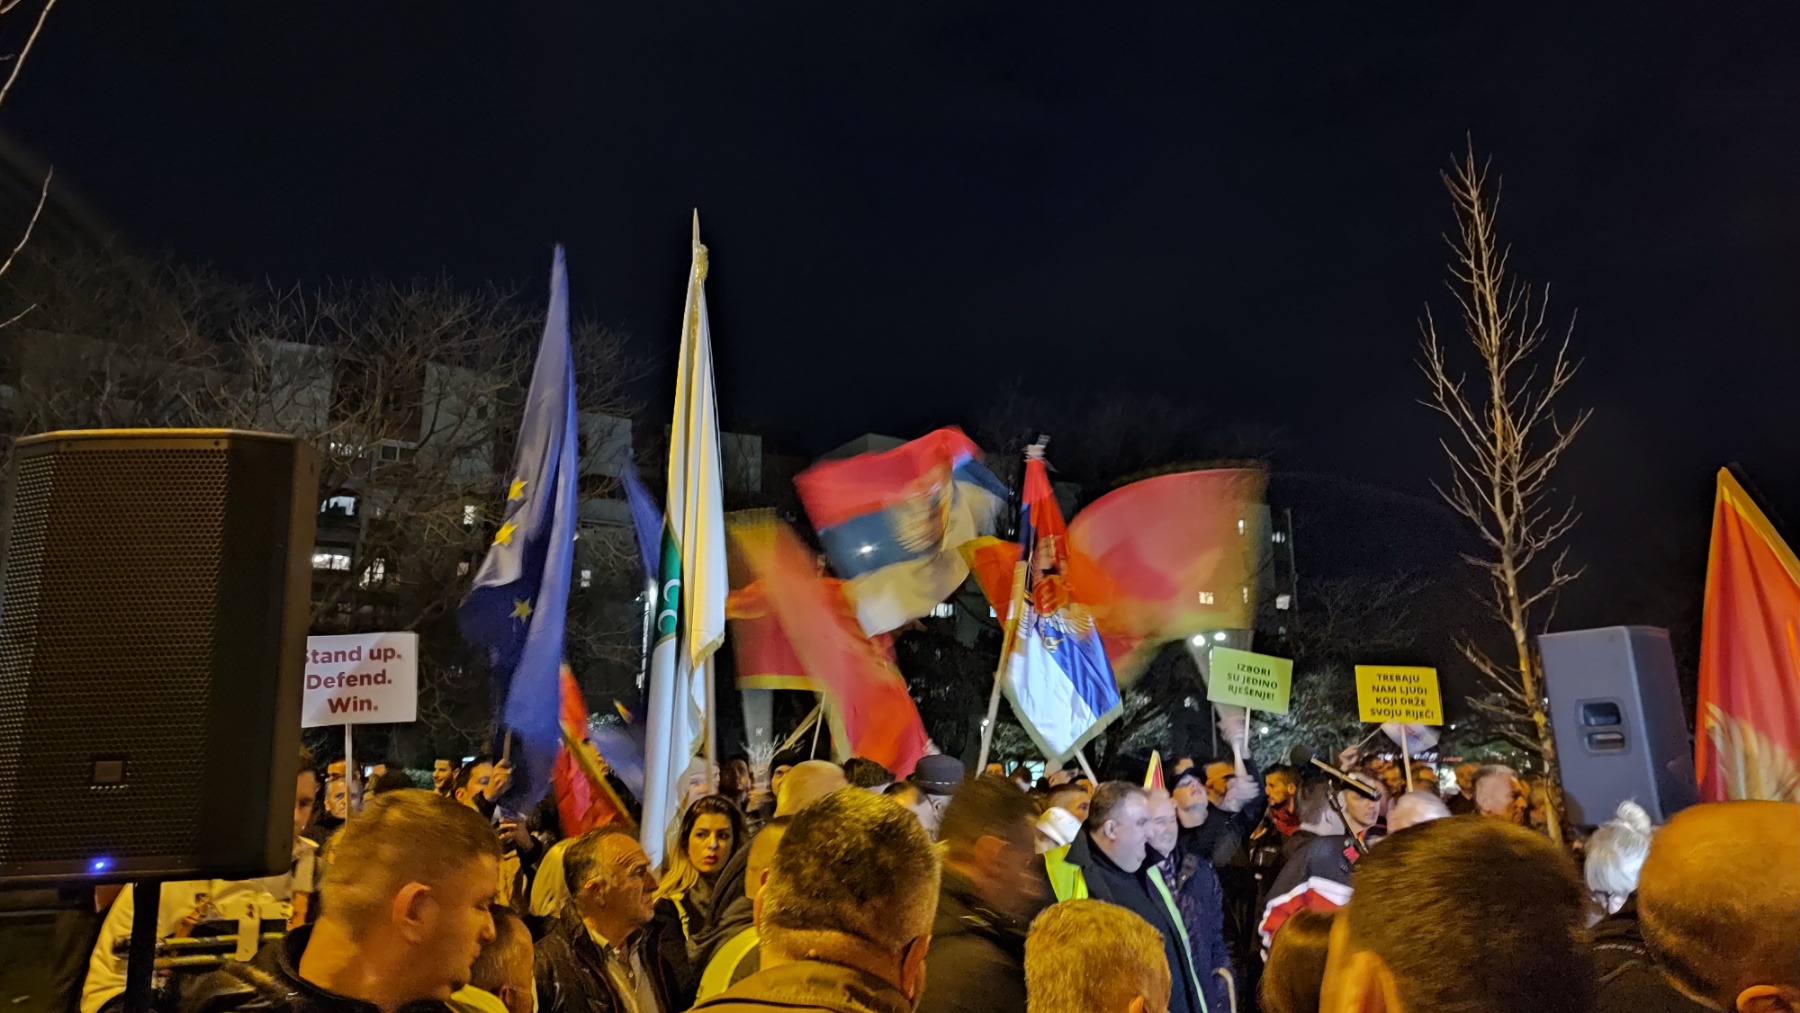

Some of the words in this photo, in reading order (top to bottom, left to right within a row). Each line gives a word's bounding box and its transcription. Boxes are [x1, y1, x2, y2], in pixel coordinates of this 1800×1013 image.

[369, 646, 403, 663] up.
[1237, 663, 1271, 677] IZBORI
[306, 669, 393, 690] Defend.
[1227, 672, 1240, 682] SU
[1241, 676, 1278, 689] JEDINO
[1376, 673, 1420, 684] TREBAJU
[1228, 684, 1275, 701] RJEŠENJE!
[1371, 685, 1397, 694] NAM
[1400, 686, 1427, 696] LJUDI
[327, 696, 379, 714] Win.
[1376, 697, 1397, 706] KOJI
[1400, 696, 1426, 707] DRŽE
[1370, 708, 1402, 719] SVOJU
